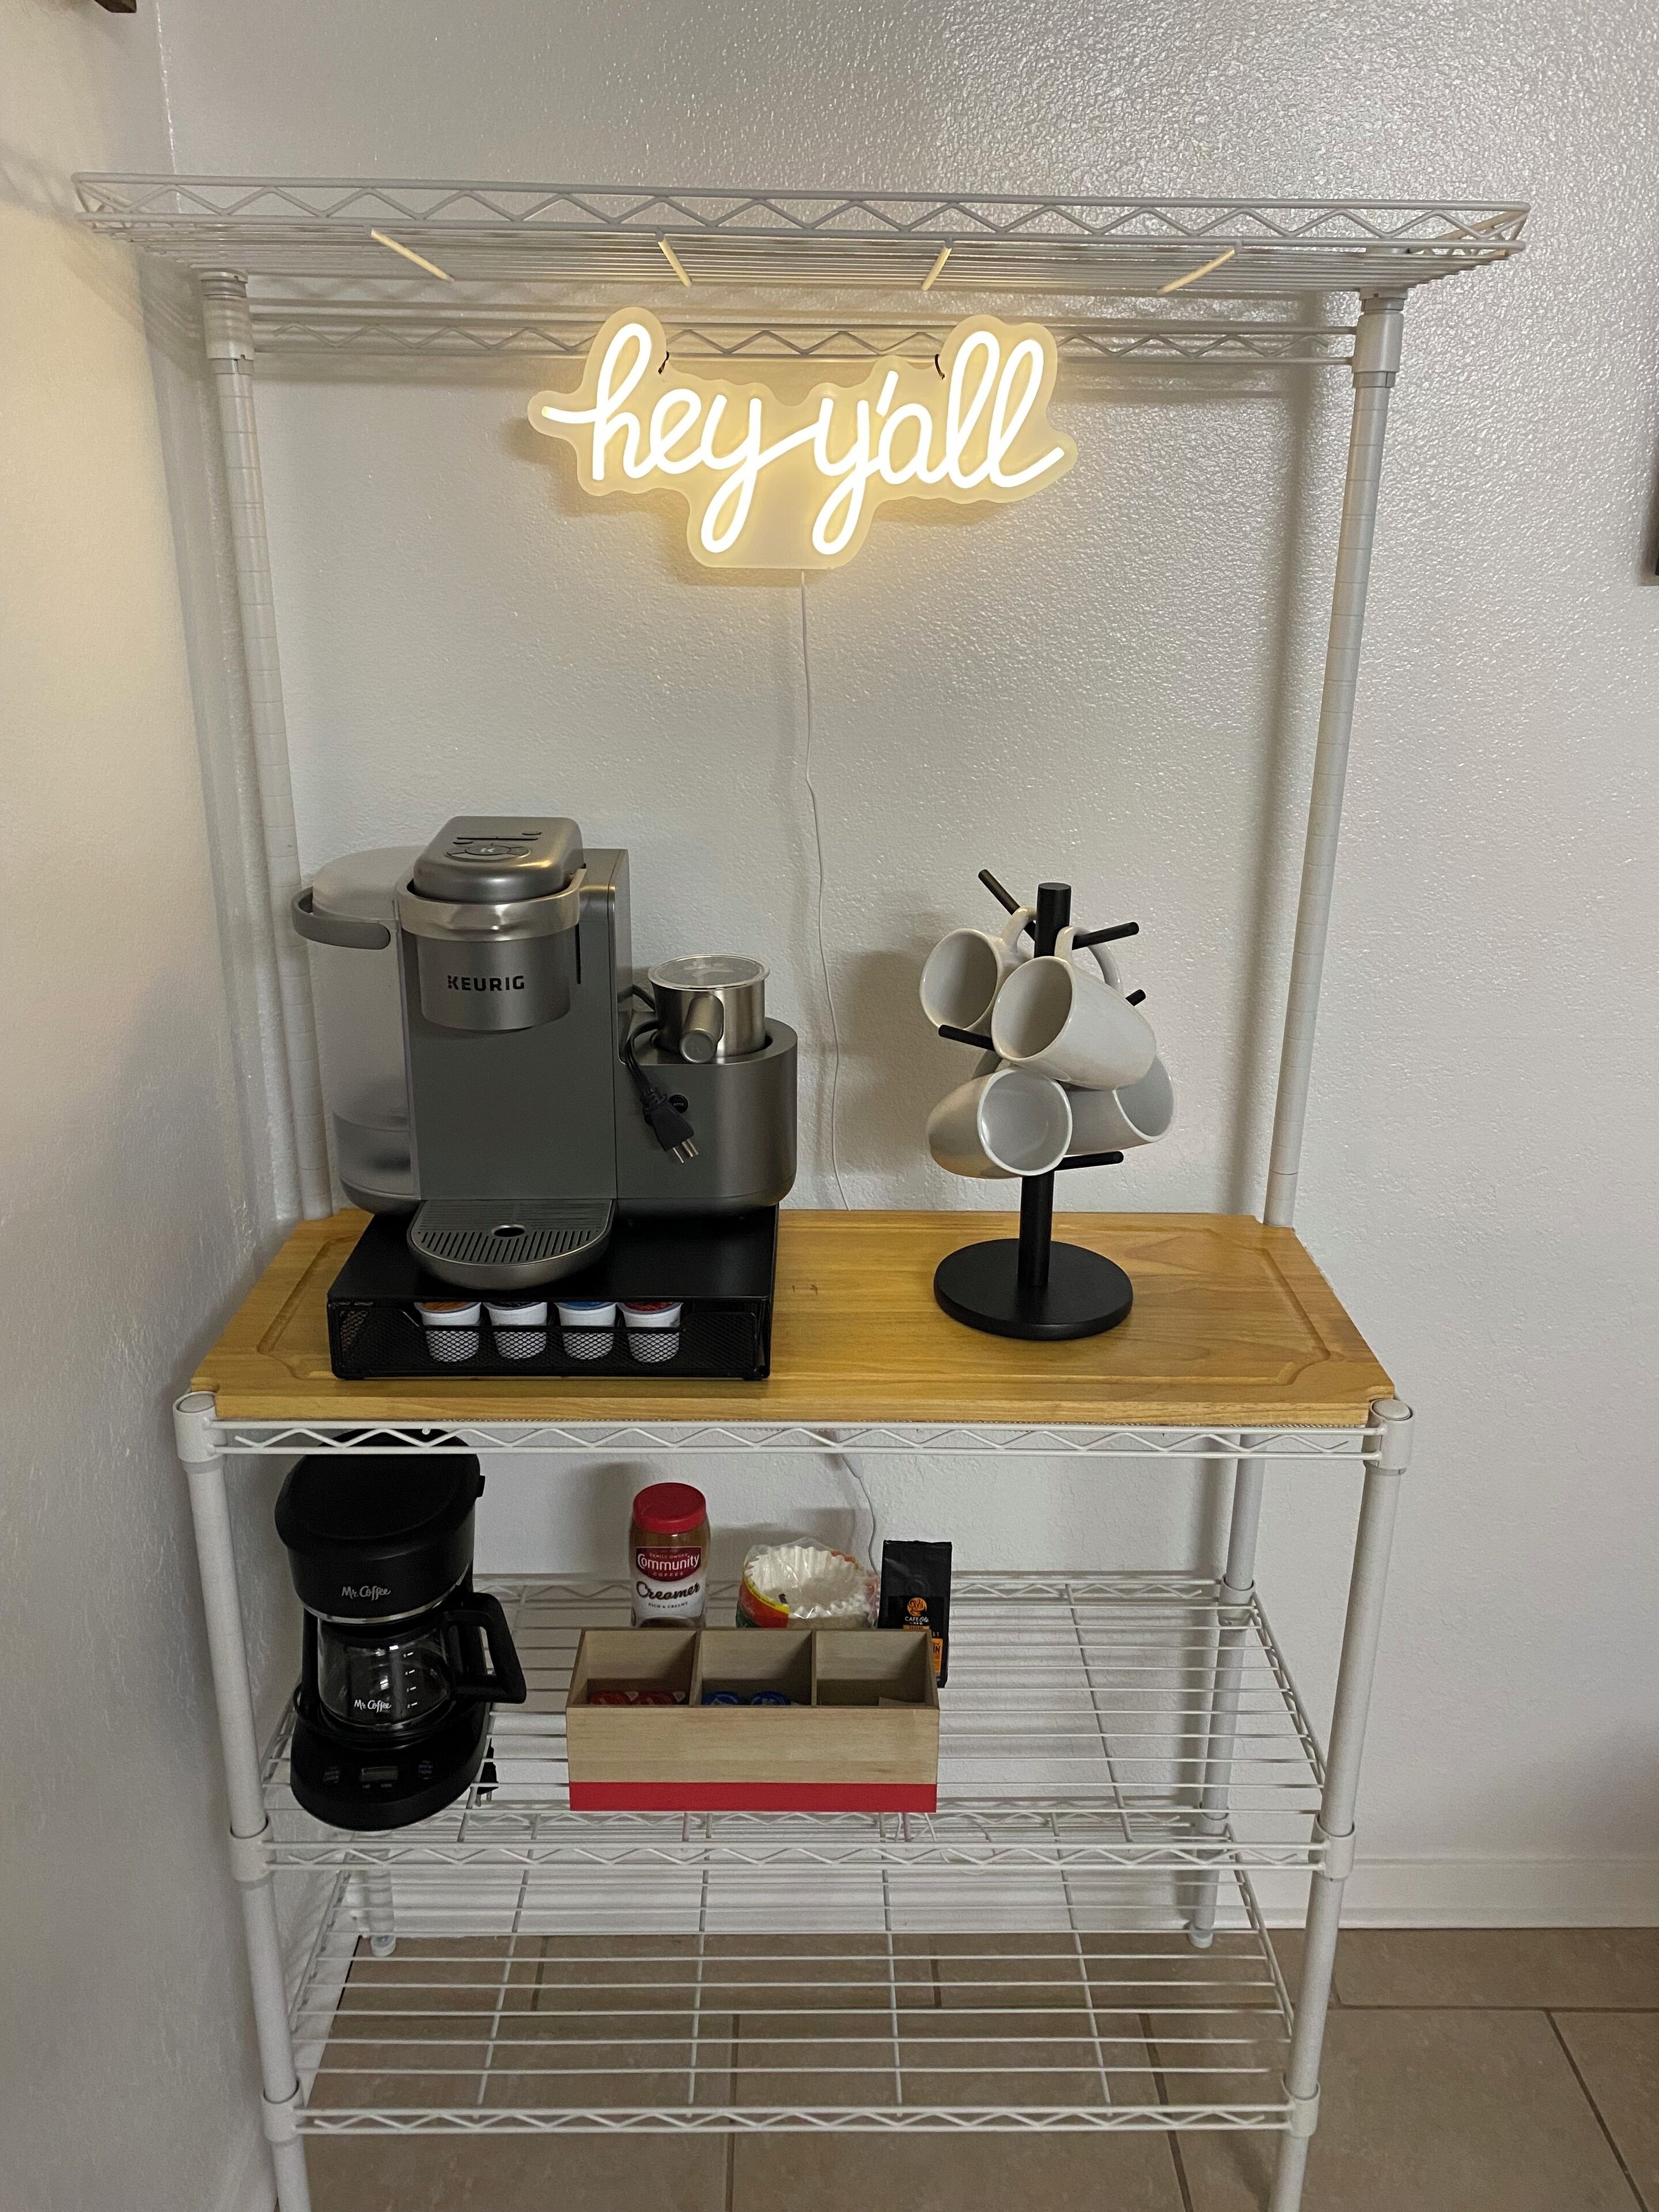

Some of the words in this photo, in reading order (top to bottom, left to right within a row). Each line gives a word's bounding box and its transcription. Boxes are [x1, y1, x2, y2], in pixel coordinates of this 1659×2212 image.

[541, 323, 778, 553] hey
[812, 330, 1065, 555] y'all
[447, 974, 525, 992] KEURIG
[637, 1553, 700, 1571] Community
[341, 1586, 358, 1600] Mr.
[359, 1585, 391, 1601] Coffee
[636, 1581, 700, 1600] Creamer
[367, 1699, 392, 1713] Coffee
